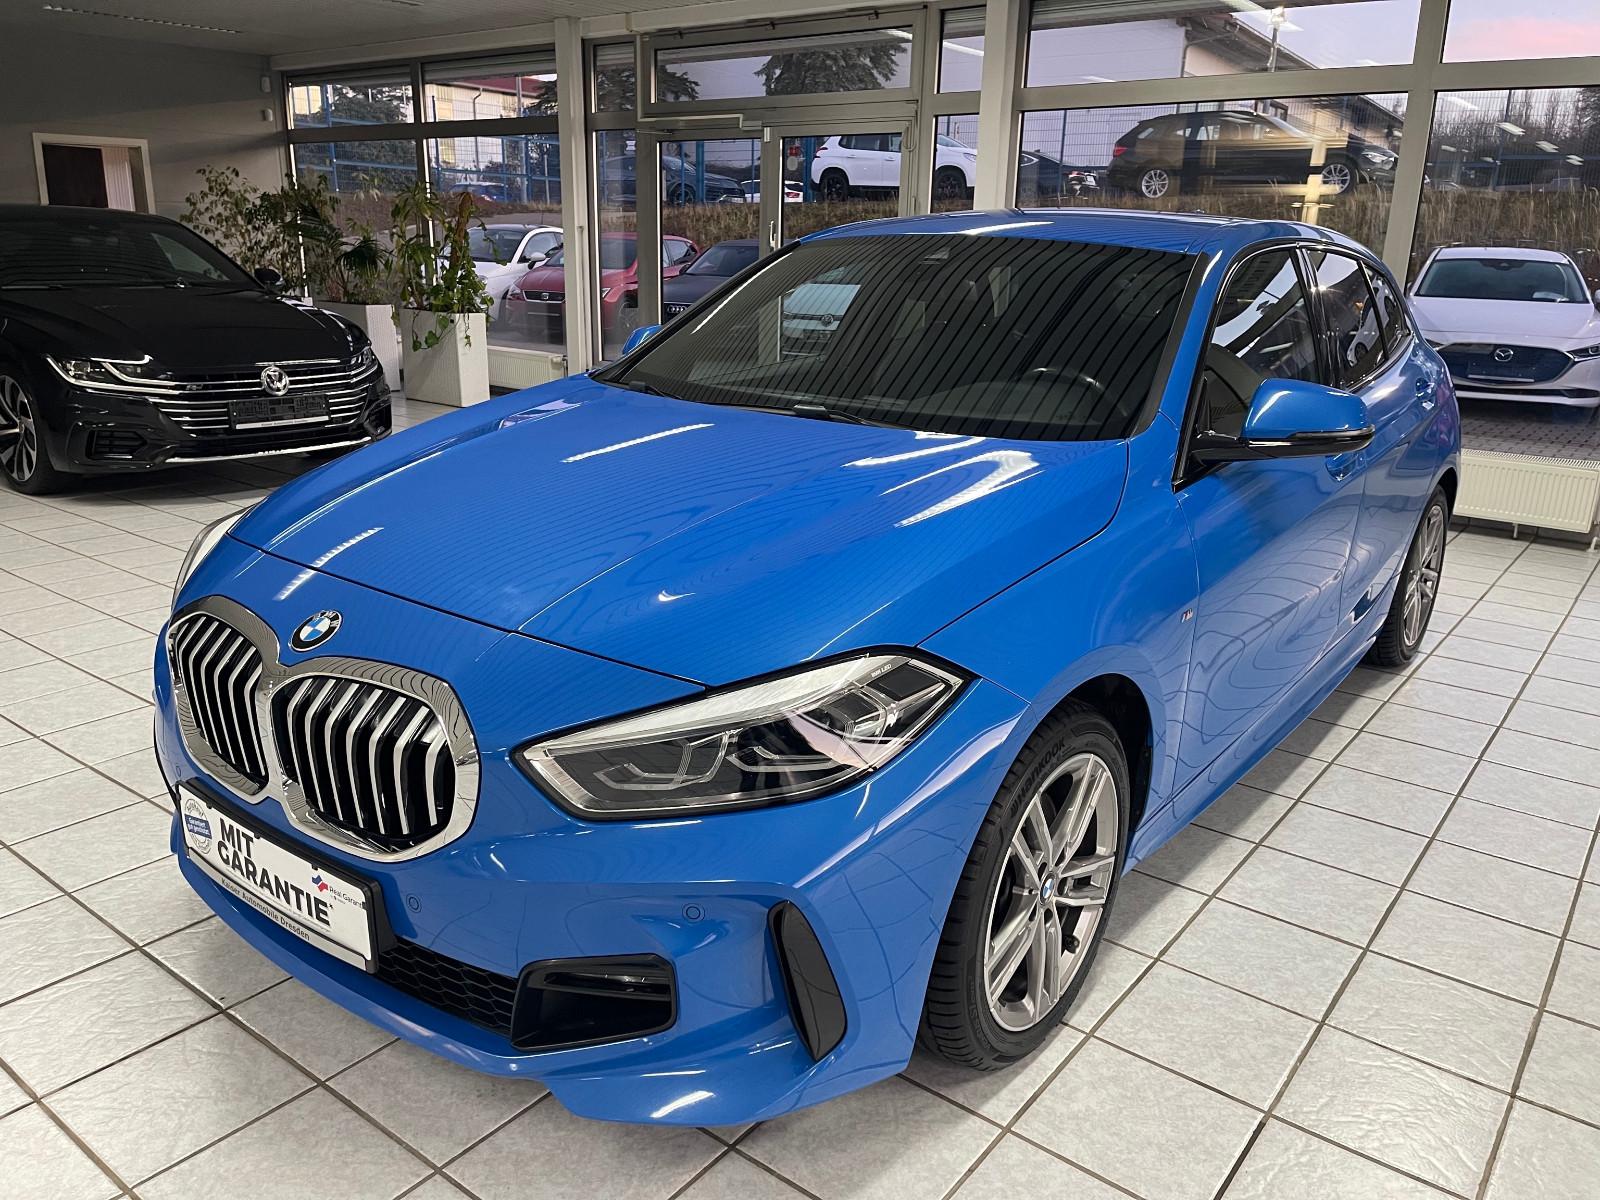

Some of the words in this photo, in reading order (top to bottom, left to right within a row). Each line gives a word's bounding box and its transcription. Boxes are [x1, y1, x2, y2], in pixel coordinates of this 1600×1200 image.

[219, 817, 255, 859] MIT
[242, 891, 280, 922] Automobile
[280, 916, 311, 941] Dresden
